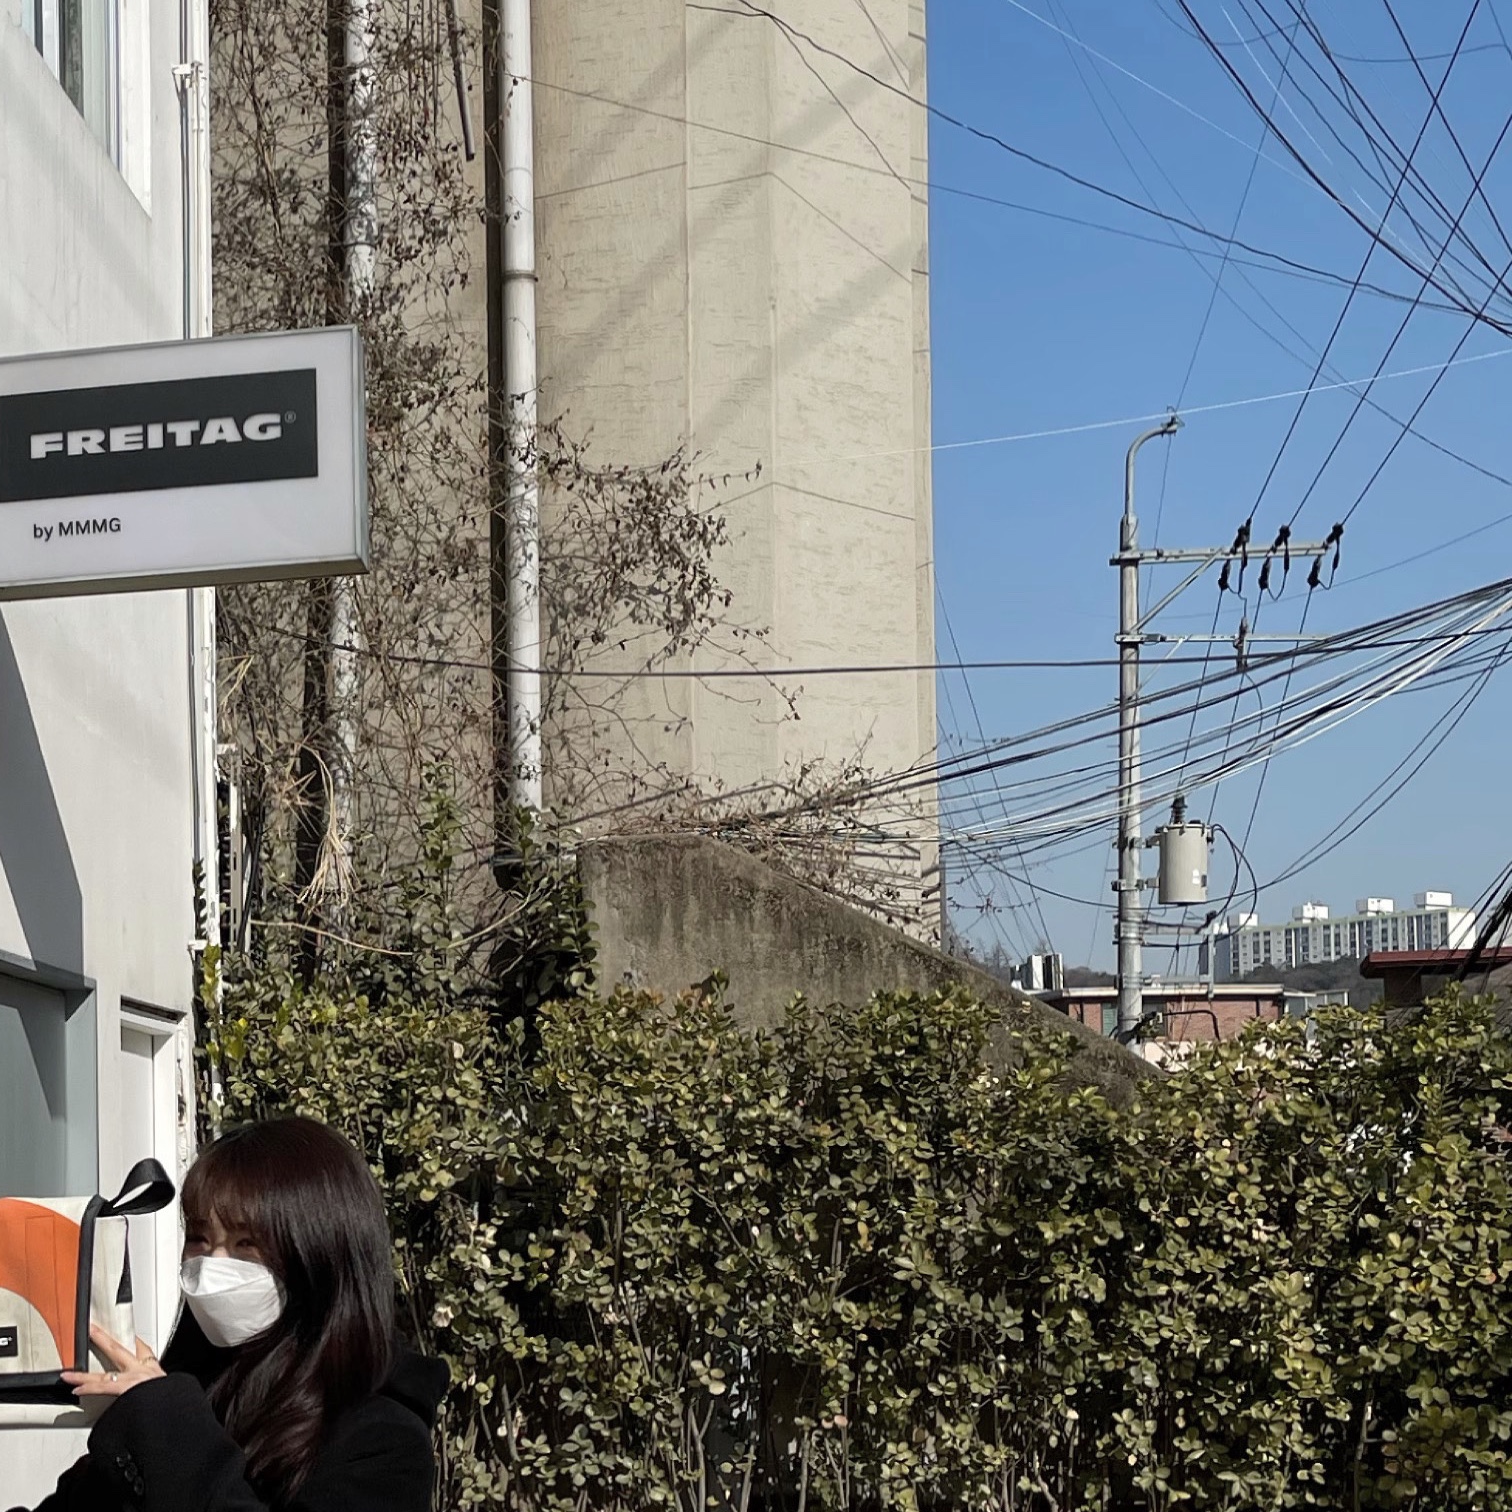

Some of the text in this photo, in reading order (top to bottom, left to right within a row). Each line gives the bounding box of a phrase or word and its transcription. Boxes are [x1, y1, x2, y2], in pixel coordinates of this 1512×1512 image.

[30, 412, 282, 459] FREITAG
[33, 517, 122, 542] by MMMG
